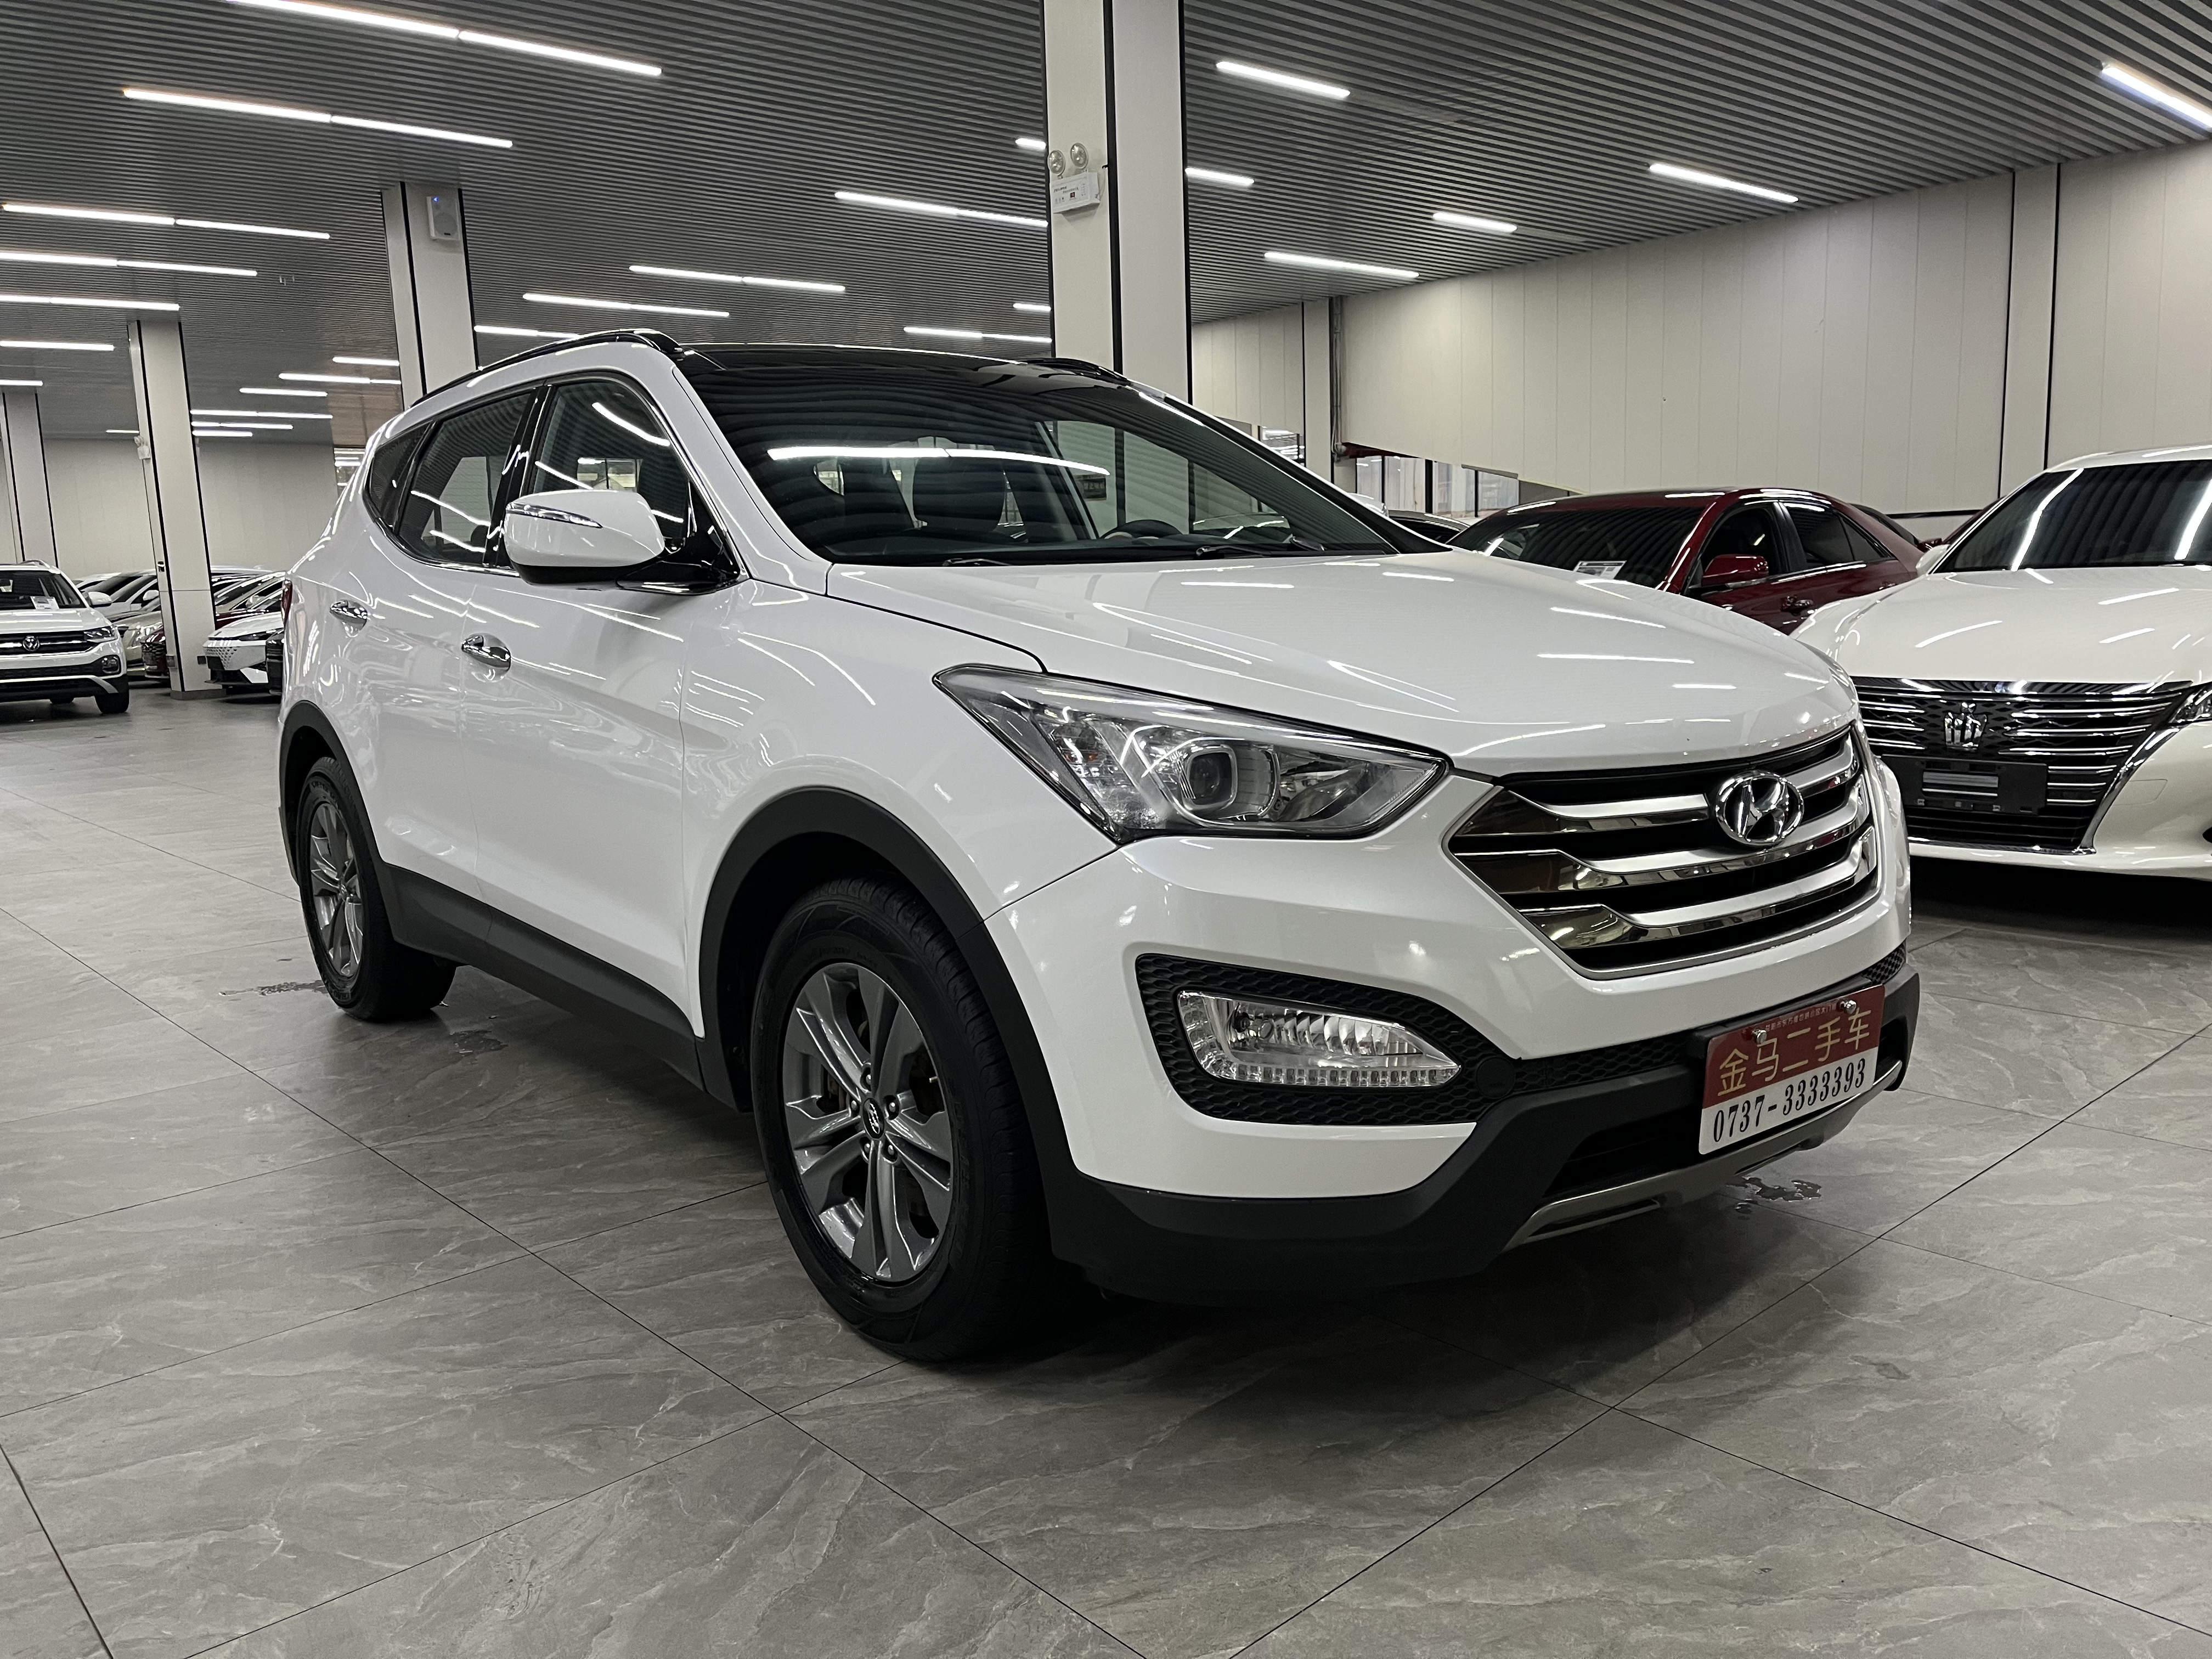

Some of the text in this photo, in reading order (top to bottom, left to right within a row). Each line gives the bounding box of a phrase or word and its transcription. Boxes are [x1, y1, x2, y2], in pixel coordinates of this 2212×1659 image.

[1718, 1008, 1871, 1096] 金马二手车
[1713, 1058, 1866, 1143] 0737-3333393
